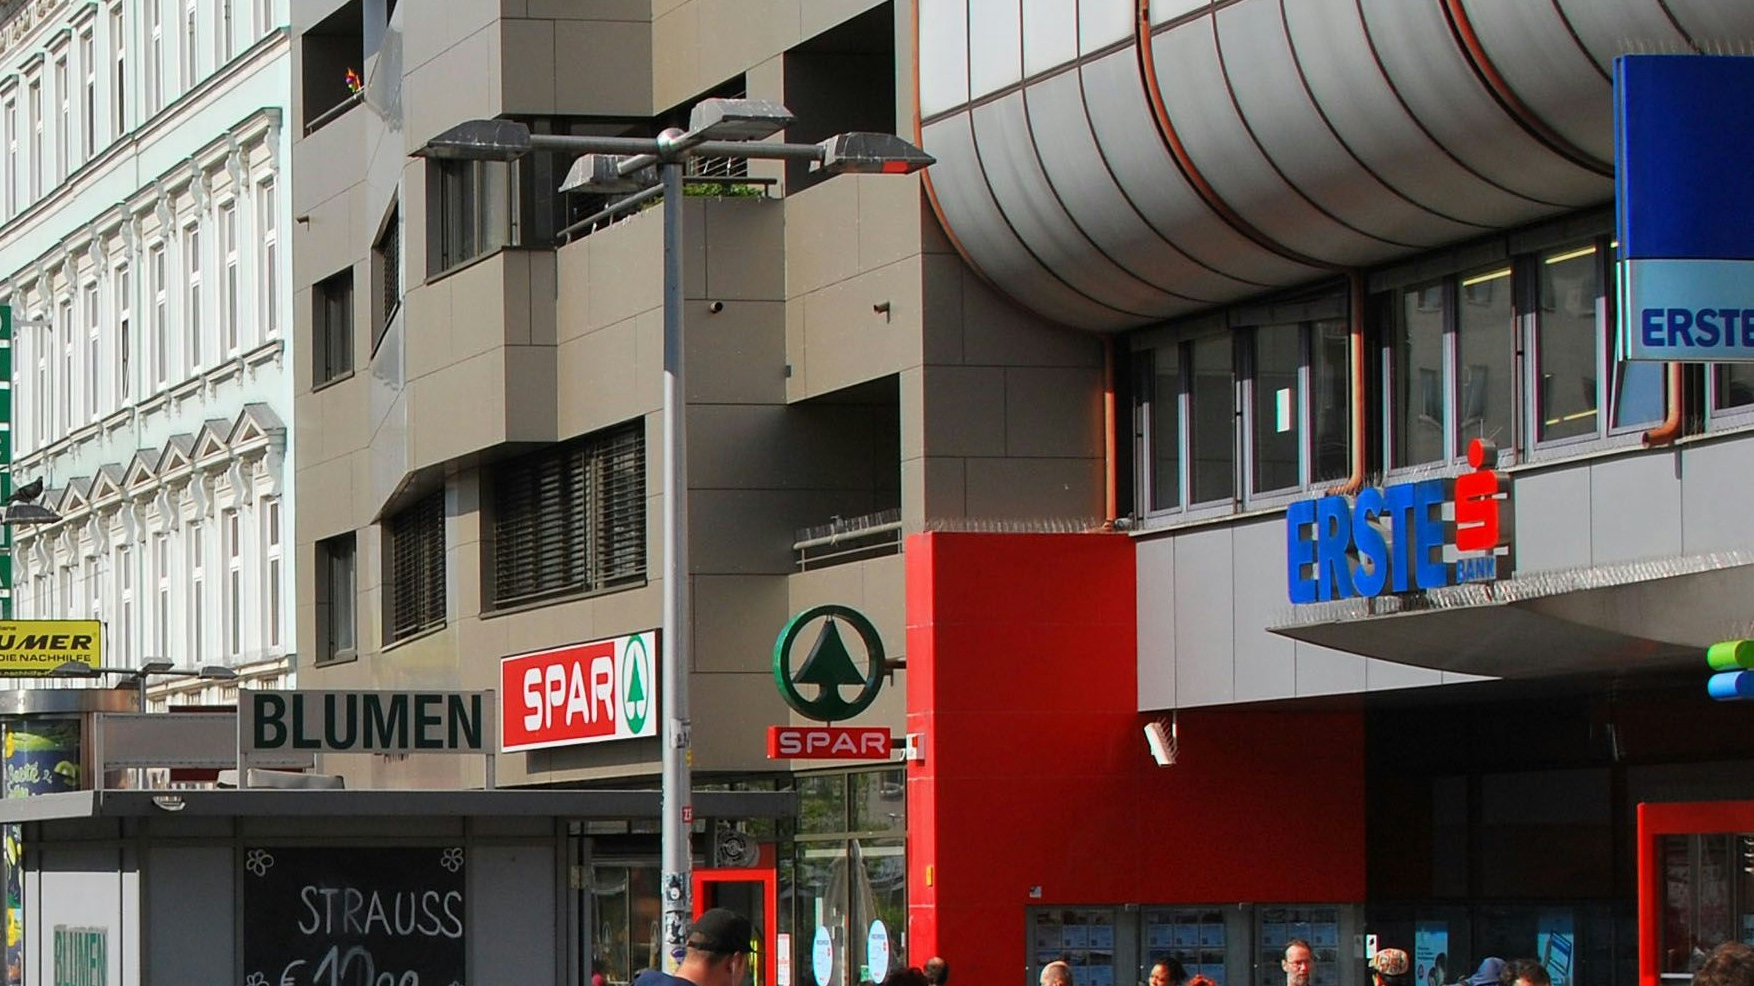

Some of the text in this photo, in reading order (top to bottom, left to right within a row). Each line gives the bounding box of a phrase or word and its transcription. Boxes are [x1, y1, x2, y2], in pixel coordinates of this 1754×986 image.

[1642, 308, 1754, 347] ERSTE
[1287, 478, 1448, 605] ERSTE
[1456, 554, 1495, 584] BANK
[523, 656, 614, 732] SPAR
[253, 694, 481, 749] BLUMEN
[779, 732, 886, 754] SPAR
[298, 886, 463, 937] STRAUSS
